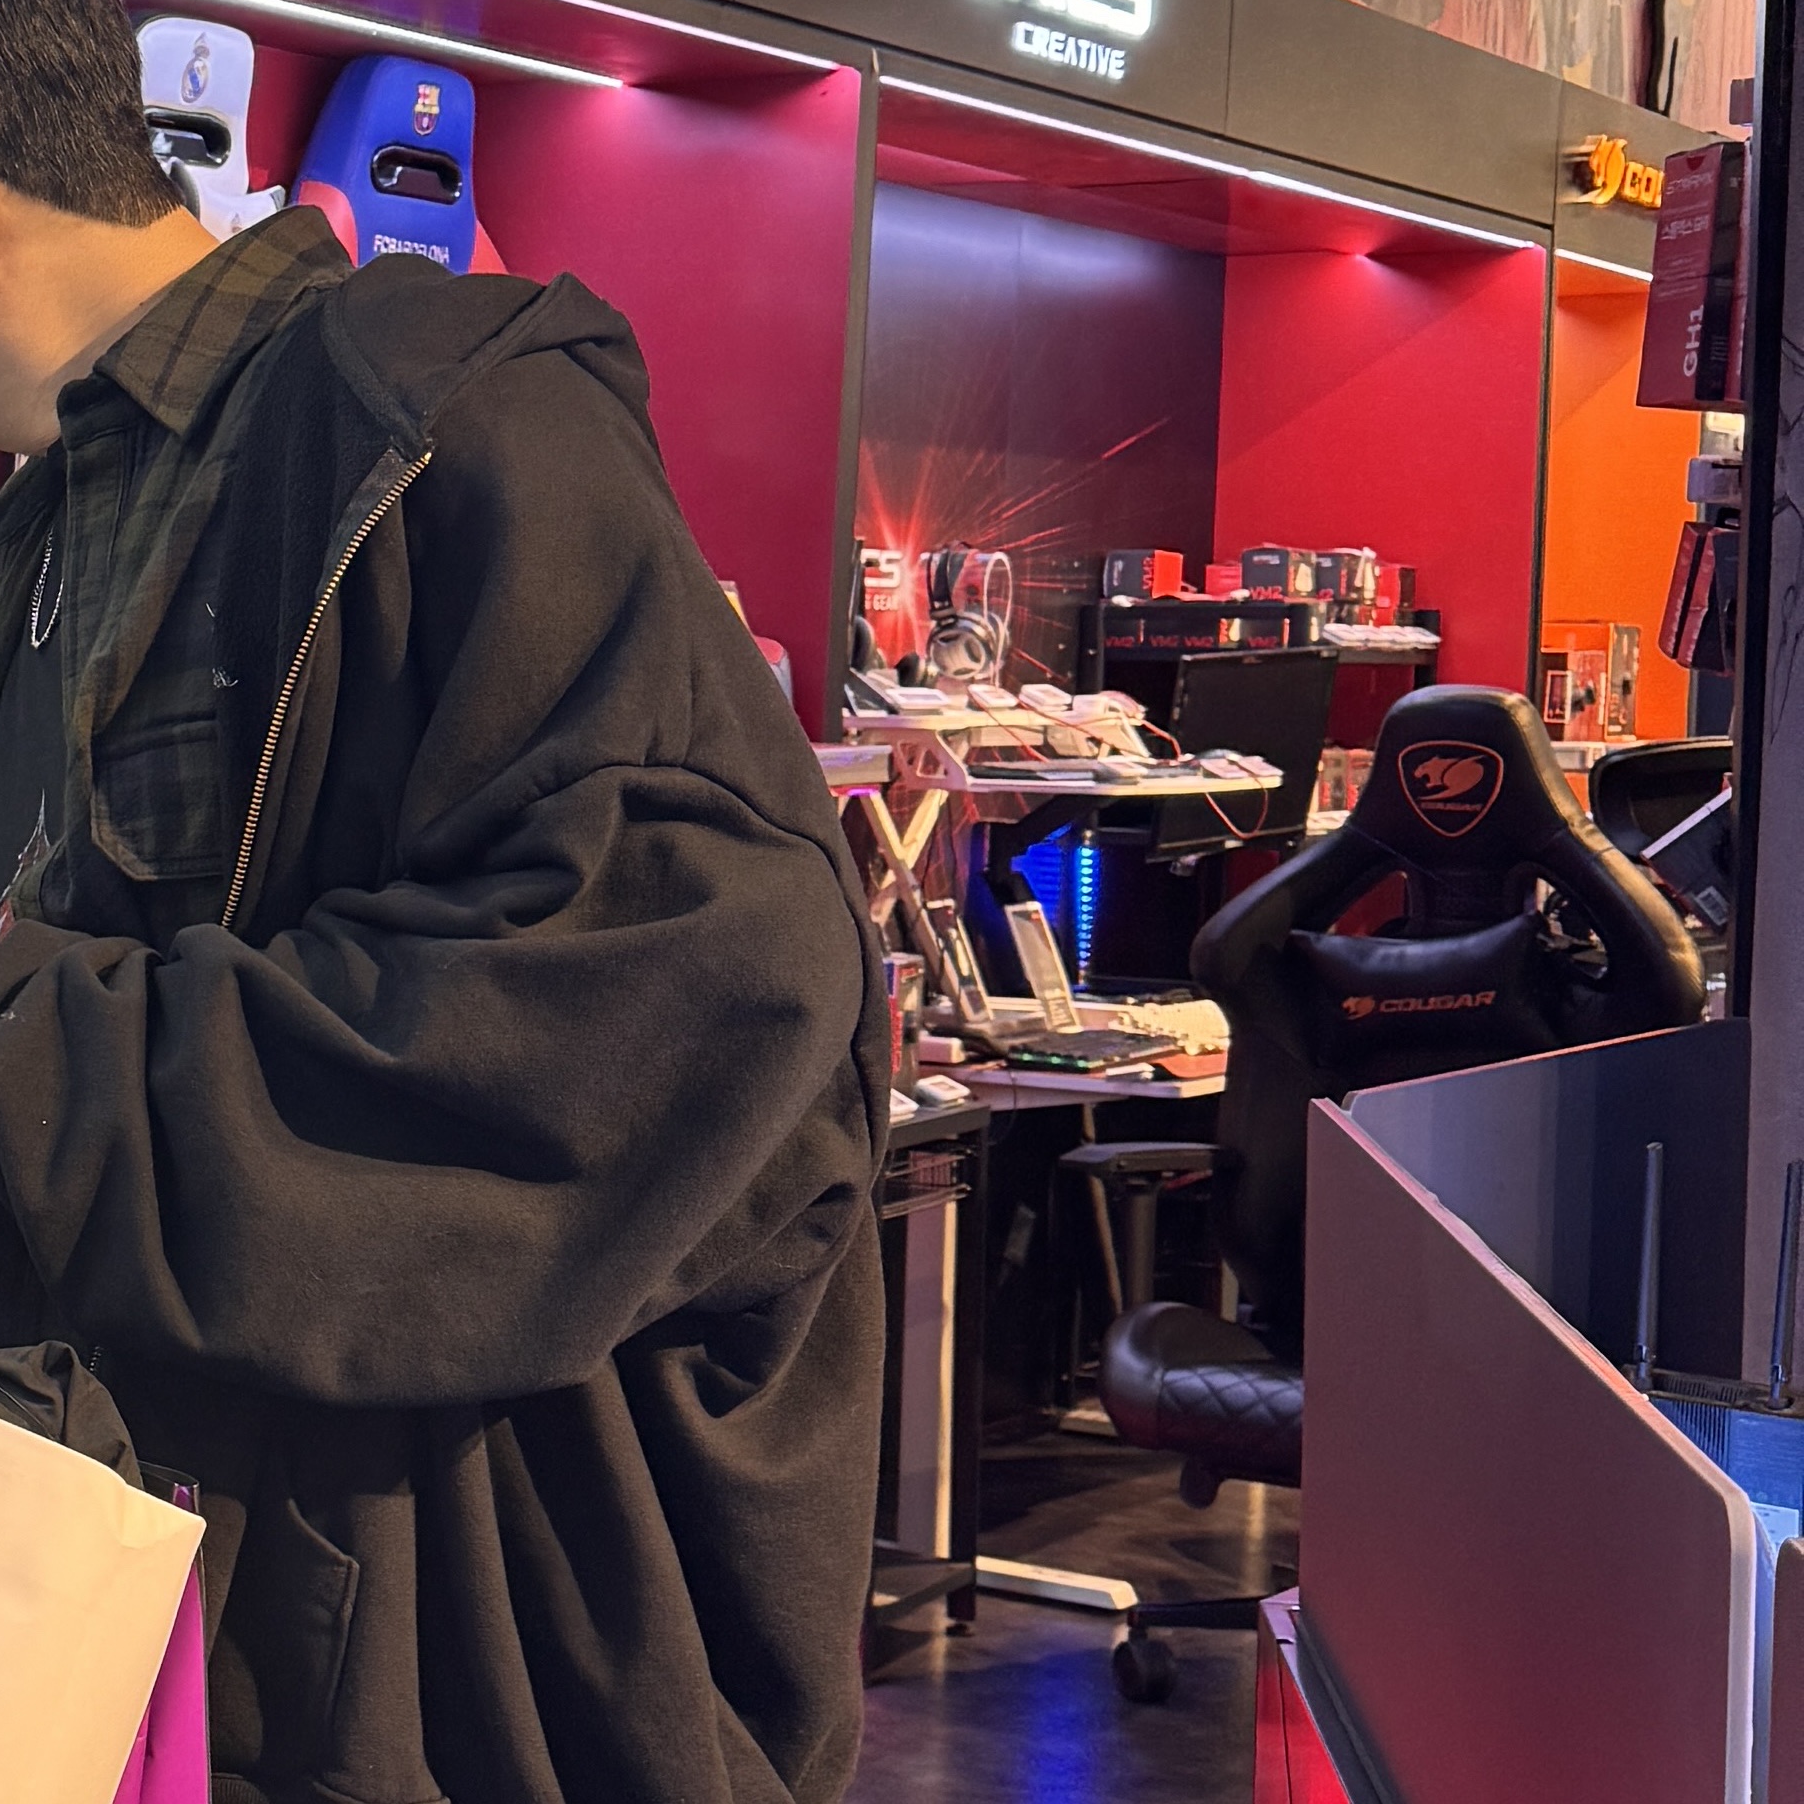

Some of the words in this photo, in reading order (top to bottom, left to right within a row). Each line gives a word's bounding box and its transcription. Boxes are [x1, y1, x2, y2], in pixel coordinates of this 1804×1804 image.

[1014, 21, 1127, 80] CREATIVE
[1249, 586, 1284, 601] VM2
[1379, 990, 1497, 1013] COUGAR
